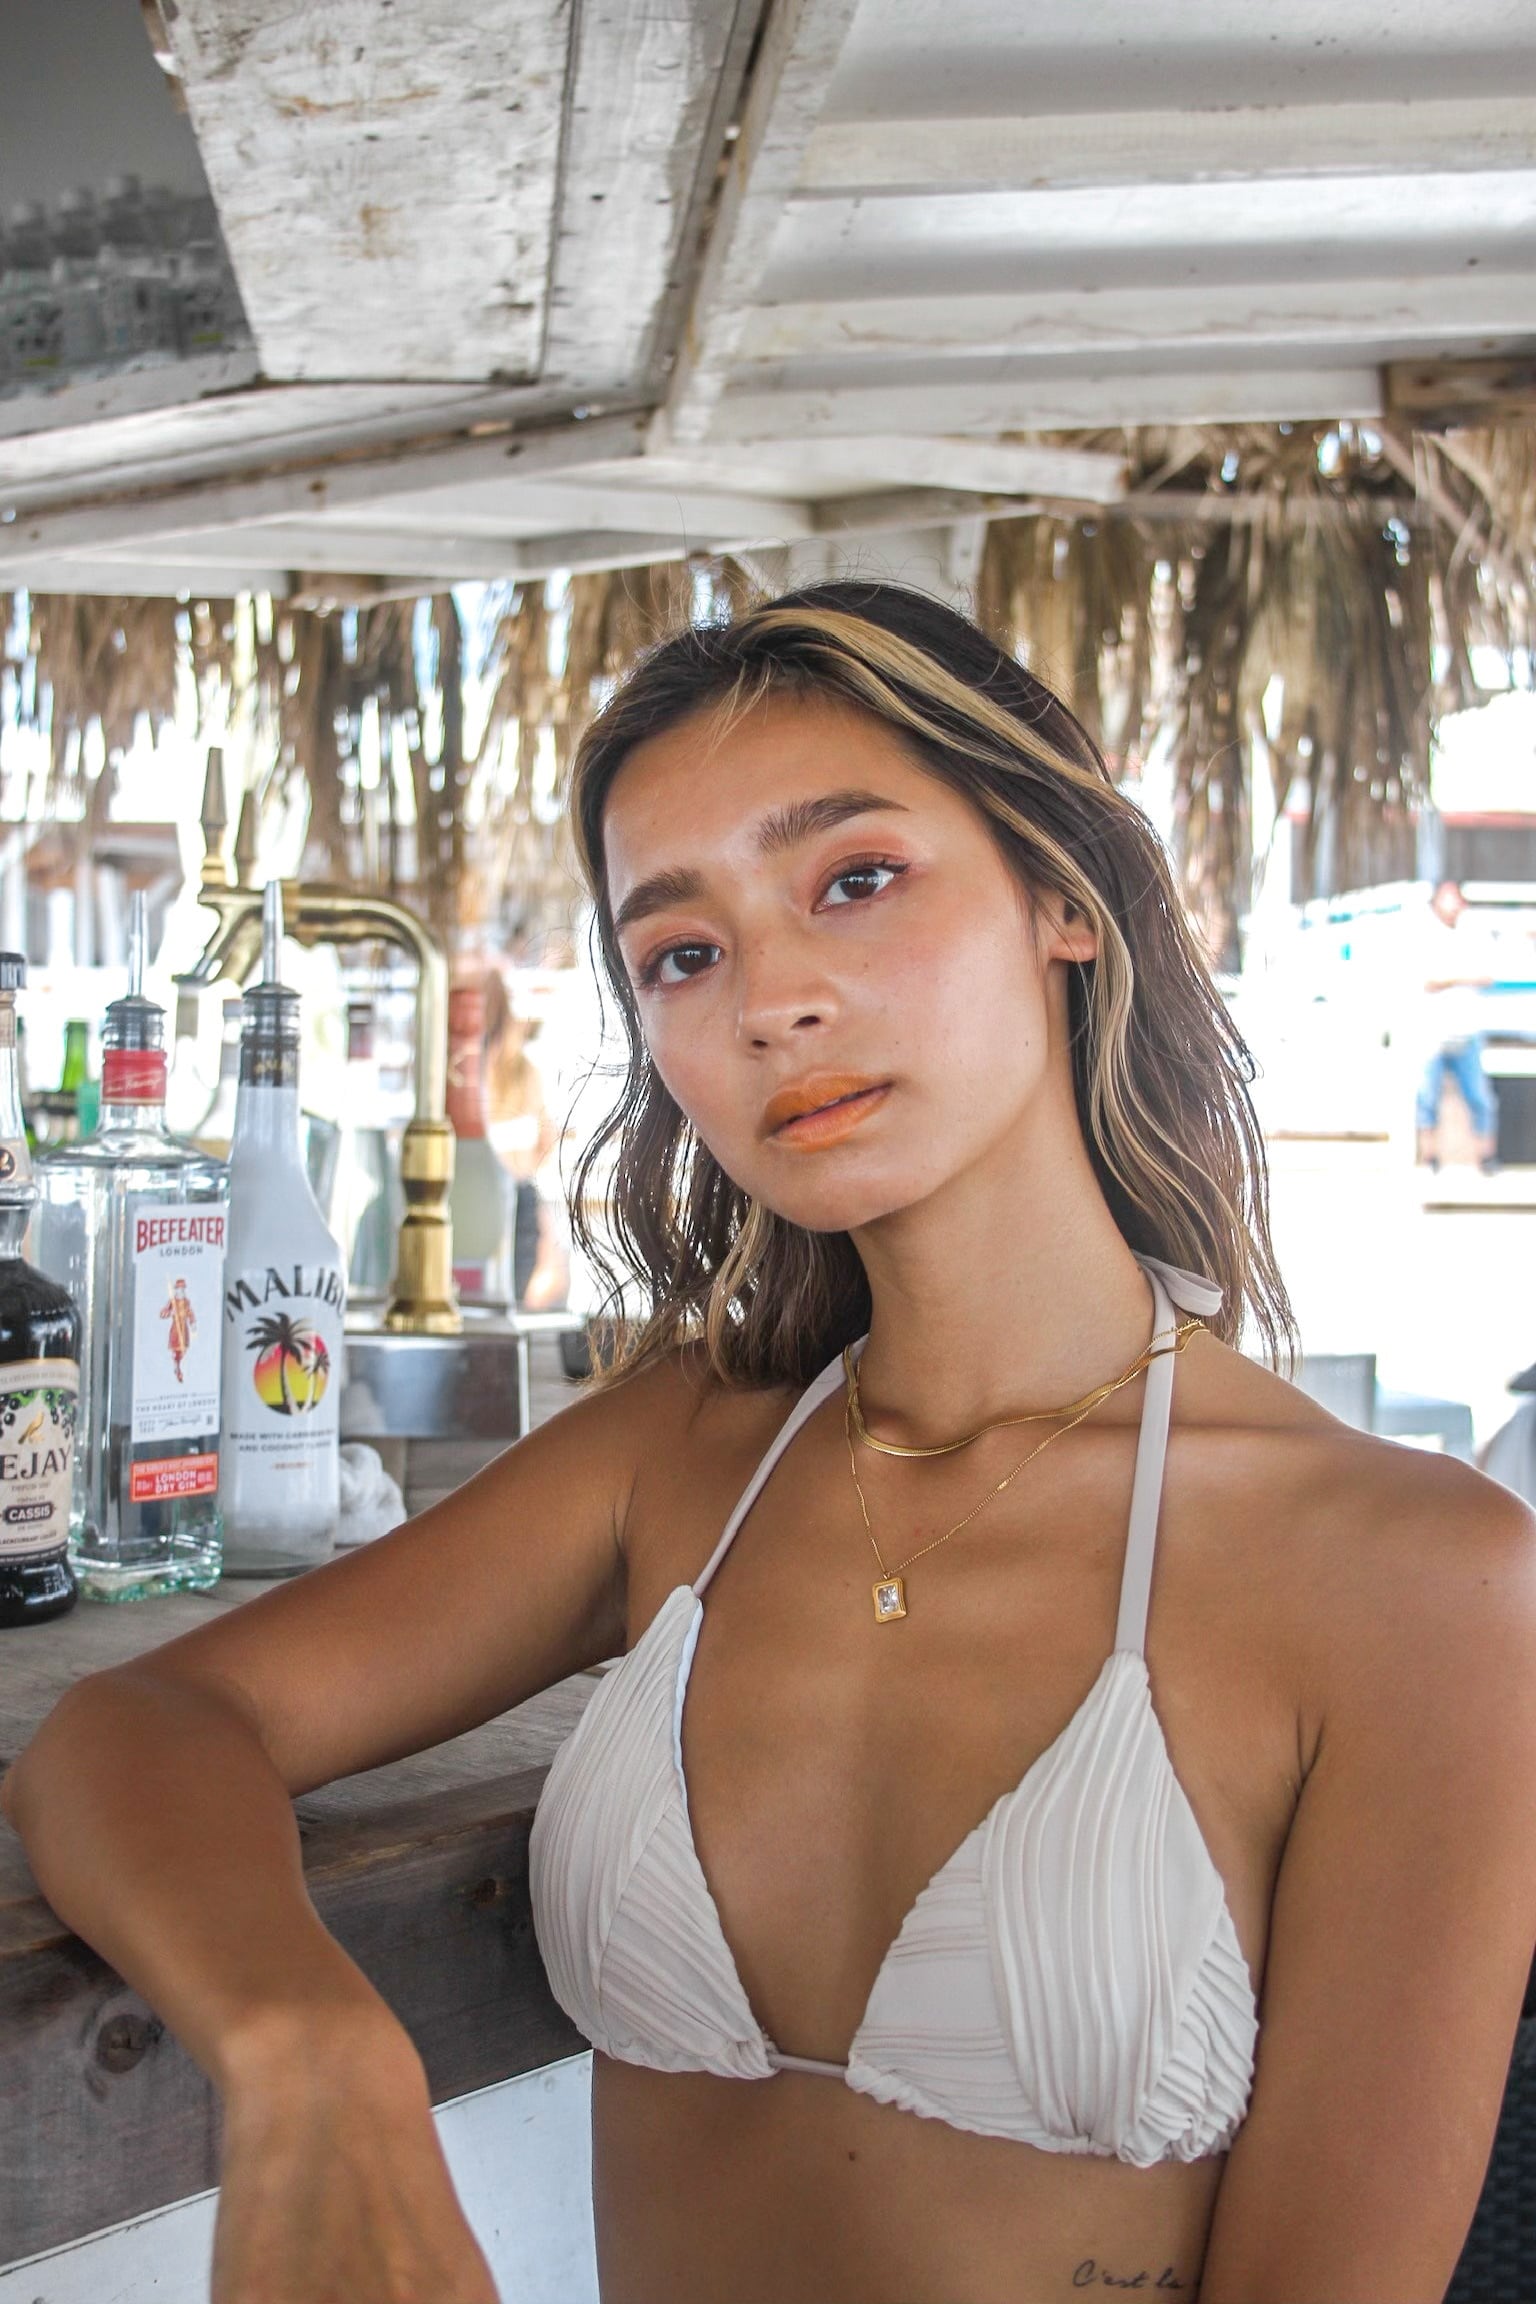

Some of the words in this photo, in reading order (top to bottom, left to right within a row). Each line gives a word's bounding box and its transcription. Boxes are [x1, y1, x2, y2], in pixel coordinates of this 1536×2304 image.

[136, 1216, 225, 1254] BEEFEATER
[160, 1246, 203, 1257] LONDON
[155, 1470, 197, 1484] LONDON
[155, 1483, 175, 1494] DRY
[177, 1480, 197, 1491] GIN
[9, 1504, 51, 1521] CASSIS
[1072, 2259, 1149, 2288] C'est
